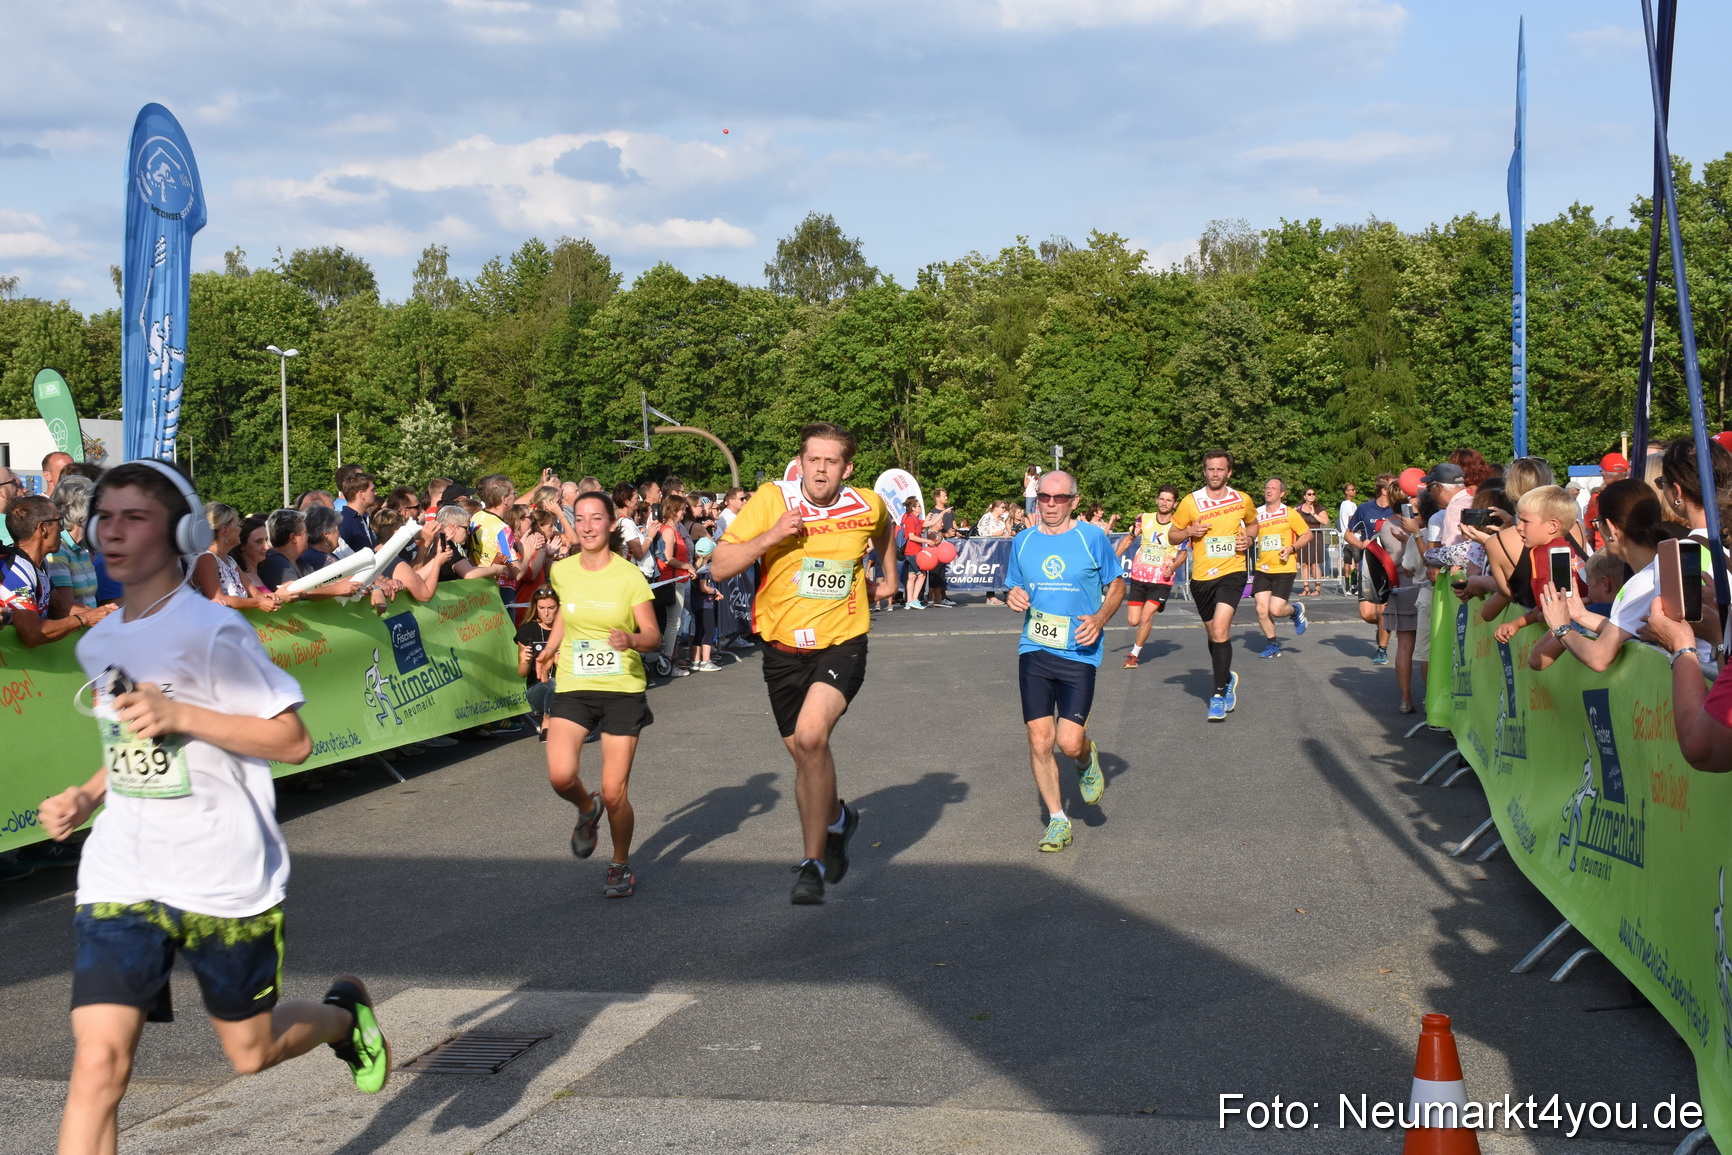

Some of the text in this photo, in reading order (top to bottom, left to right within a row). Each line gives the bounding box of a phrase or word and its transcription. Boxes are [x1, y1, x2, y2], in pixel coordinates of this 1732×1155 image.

[1200, 504, 1244, 521] MAX BÖGL
[1271, 518, 1289, 526] BÖGL
[1210, 543, 1233, 553] 1540
[1144, 553, 1161, 563] 1320
[807, 572, 846, 589] 1696
[396, 629, 416, 645] Fischer
[1034, 622, 1058, 639] 984
[578, 652, 615, 667] 1282
[389, 647, 463, 707] firmenlauf
[403, 696, 436, 719] neumarkt
[109, 746, 169, 775] 2139
[1584, 786, 1646, 868] firmenlauf
[1579, 854, 1612, 882] neumarkt
